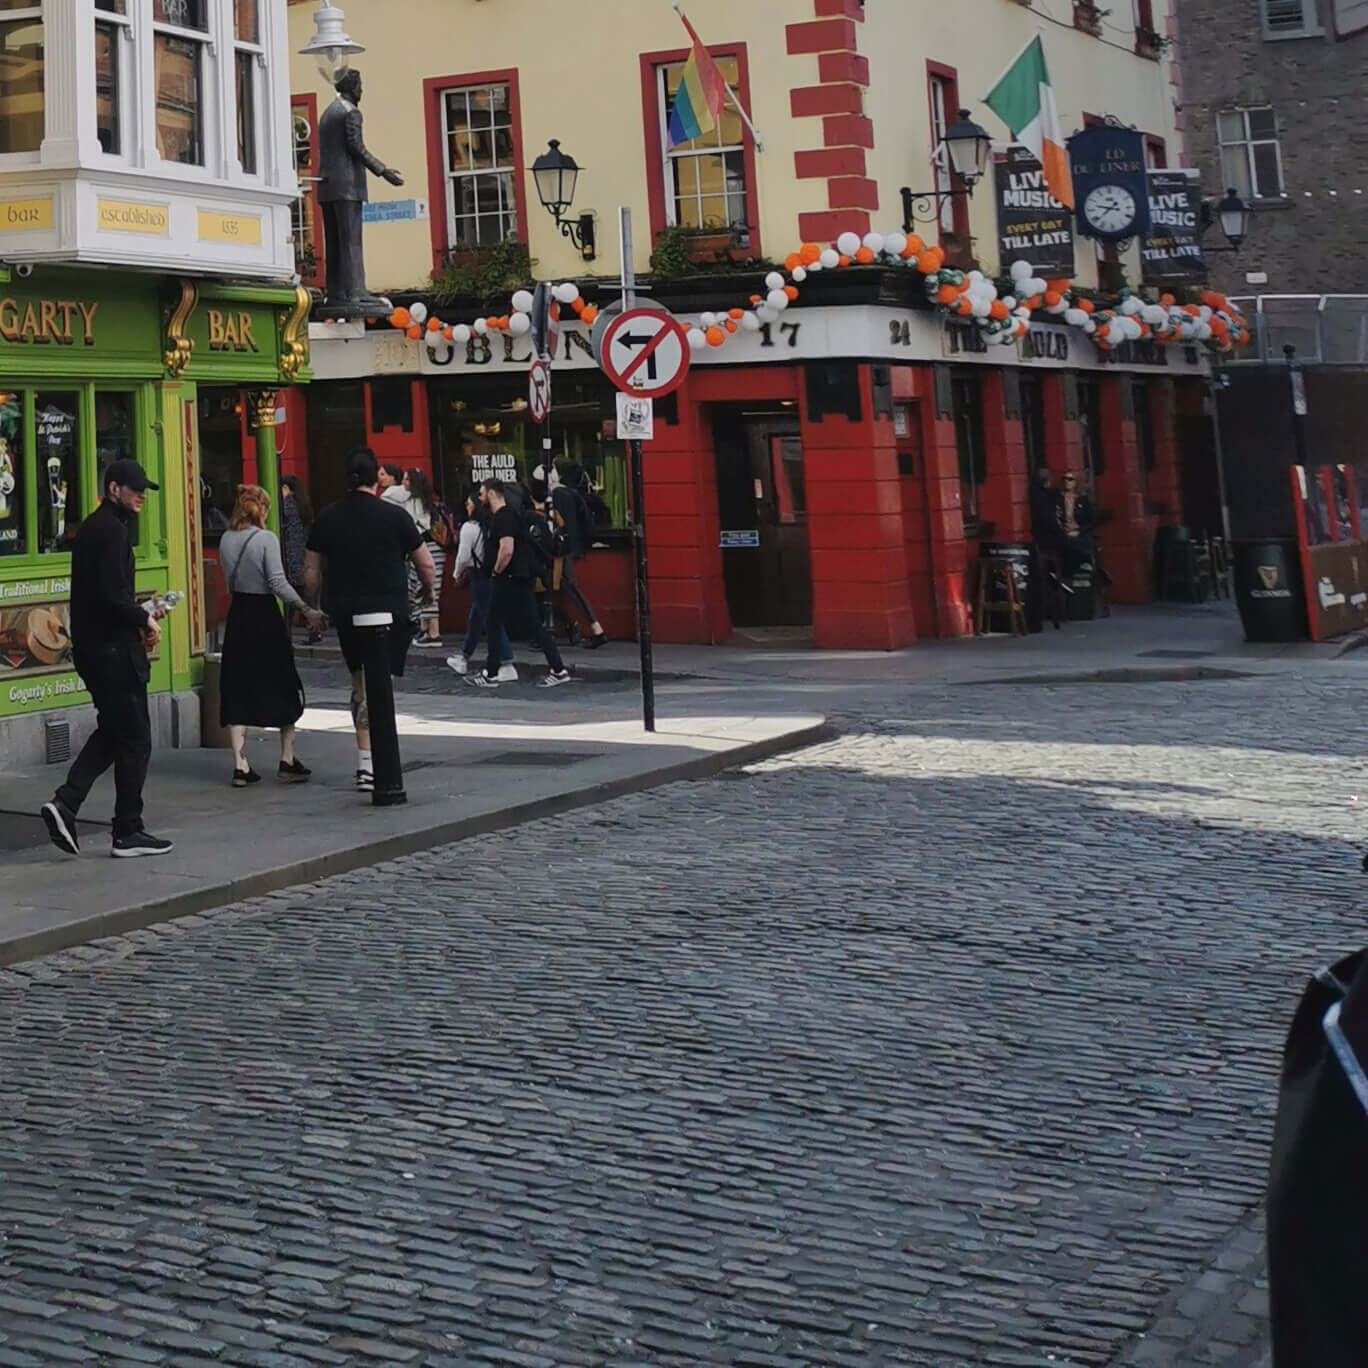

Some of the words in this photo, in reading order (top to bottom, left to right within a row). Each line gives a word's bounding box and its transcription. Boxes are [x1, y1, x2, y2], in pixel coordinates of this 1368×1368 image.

[1003, 189, 1063, 209] MUSIC
[1149, 192, 1188, 210] LIVE
[1002, 234, 1032, 250] TILL
[1033, 231, 1071, 247] LATE
[1142, 248, 1169, 260] TILL
[1170, 245, 1201, 258] LATE
[207, 309, 259, 353] BAR
[758, 322, 801, 348] 17
[472, 454, 490, 468] THE
[491, 454, 515, 468] AULD
[9, 681, 52, 705] Gogarty's
